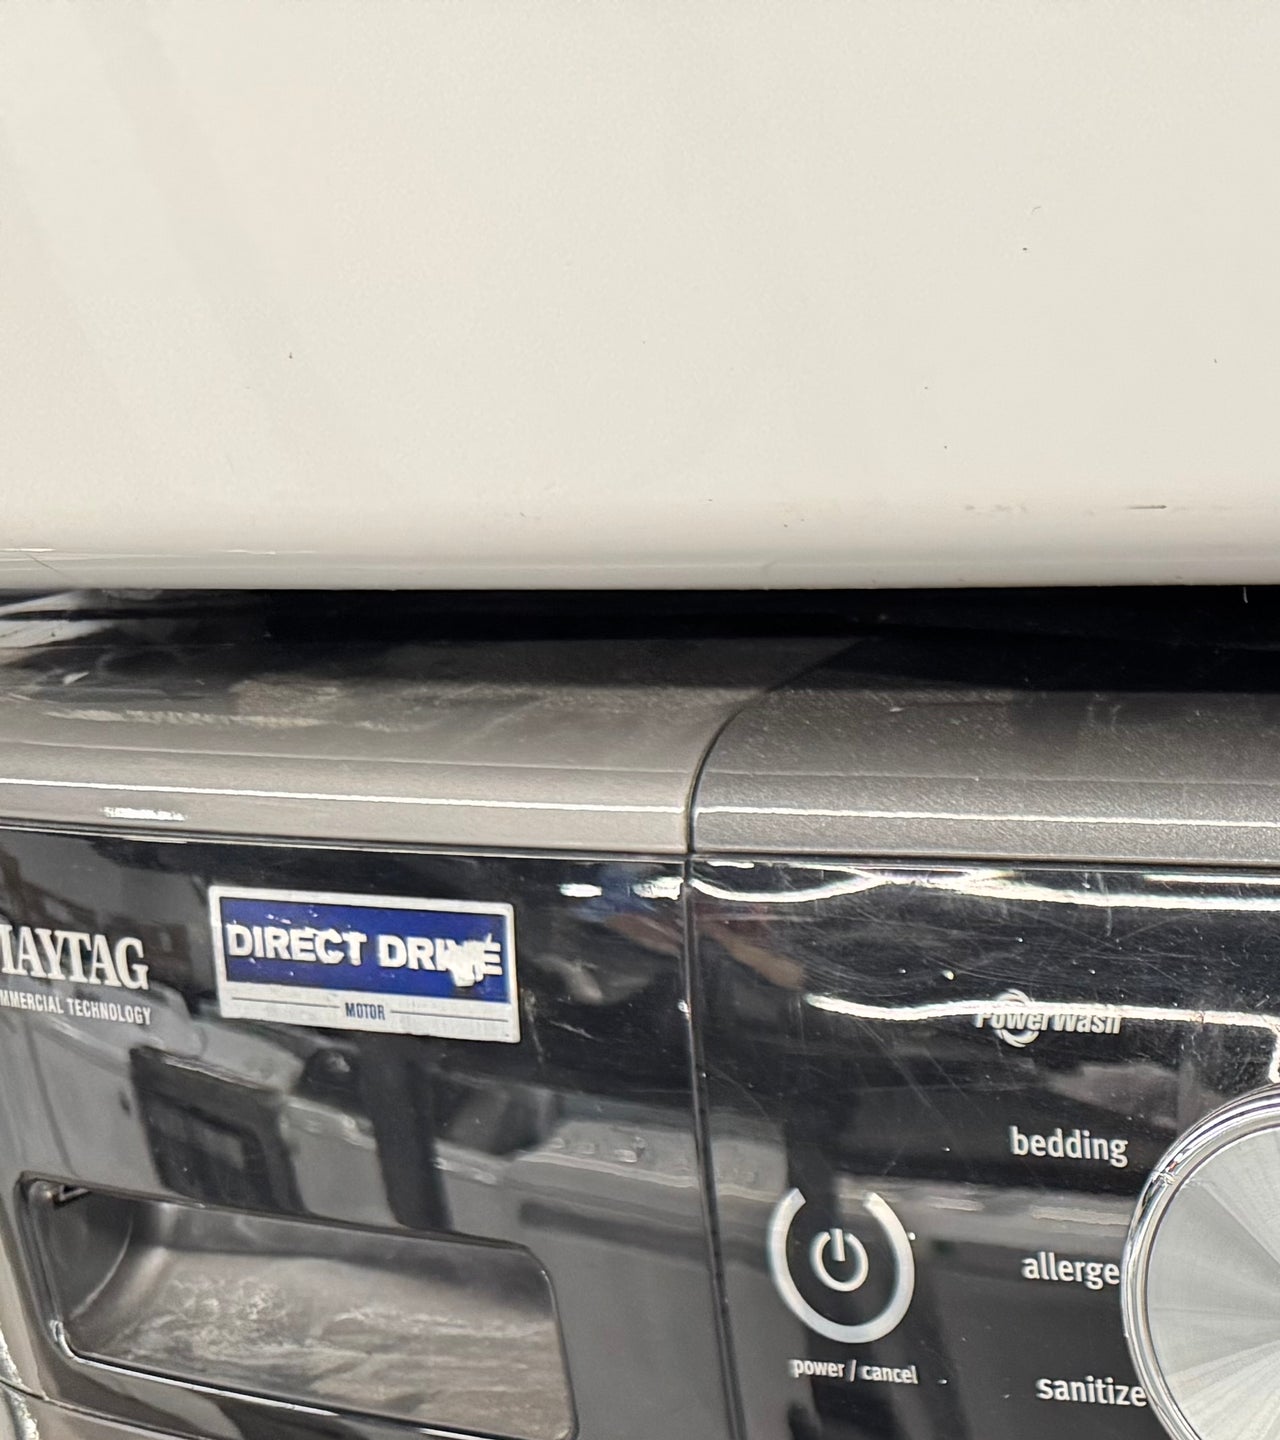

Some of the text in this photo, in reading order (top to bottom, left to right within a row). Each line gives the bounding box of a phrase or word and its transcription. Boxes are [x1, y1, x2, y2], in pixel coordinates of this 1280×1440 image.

[227, 923, 366, 965] DIRECT
[66, 998, 151, 1025] TECHNOLOGY
[345, 1003, 385, 1021] MOTOR
[1010, 1125, 1129, 1168] bedding
[793, 1360, 845, 1379] power
[862, 1365, 919, 1384] cancel
[1035, 1375, 1147, 1407] sanitize
